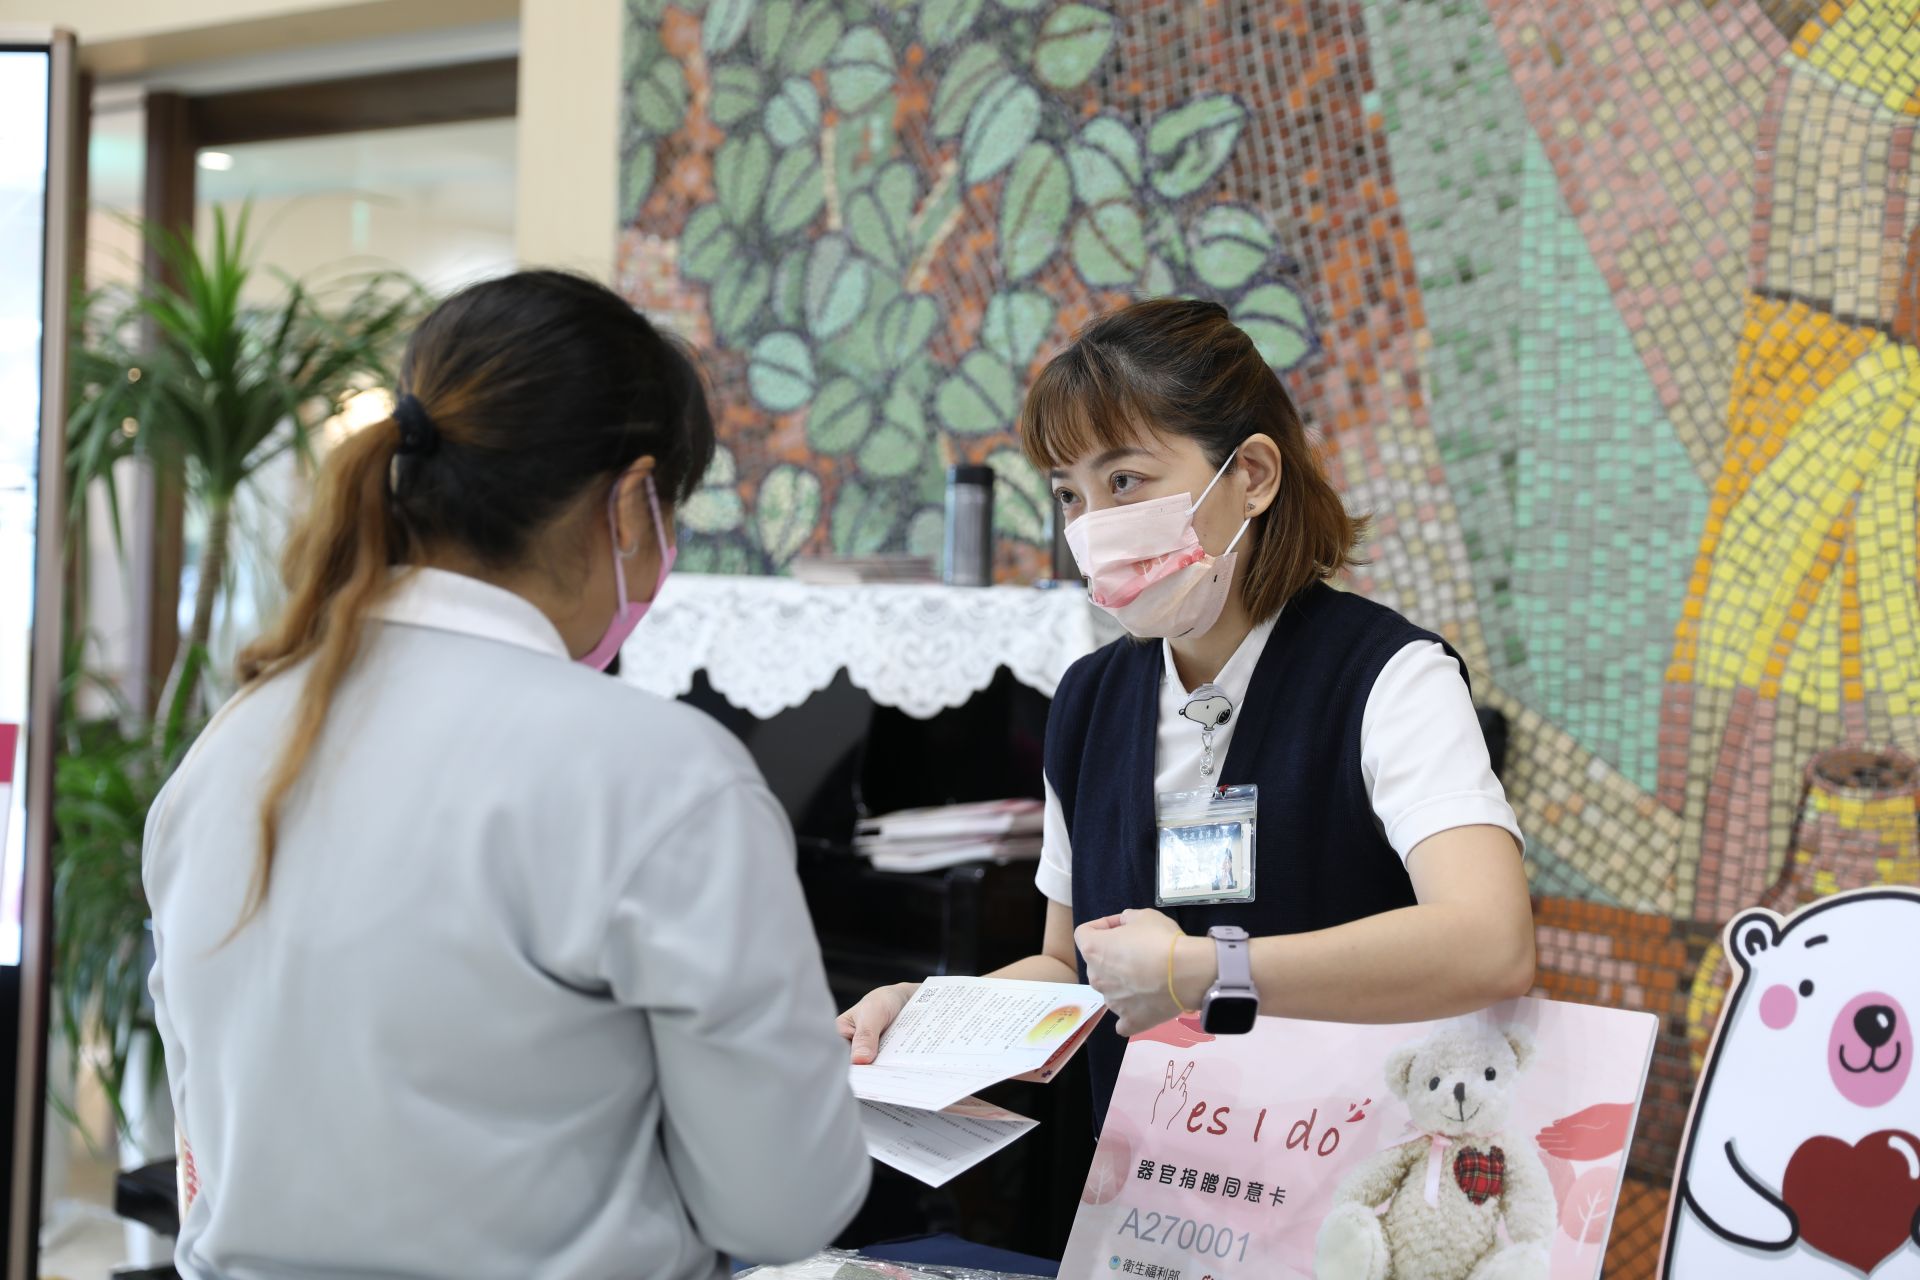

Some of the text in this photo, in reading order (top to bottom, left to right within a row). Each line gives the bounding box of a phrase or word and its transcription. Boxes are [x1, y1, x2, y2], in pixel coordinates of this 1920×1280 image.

[1253, 1108, 1267, 1143] I
[1285, 1108, 1340, 1157] do
[1136, 1159, 1287, 1207] 器官捐贈同意卡
[1117, 1207, 1250, 1263] A270001
